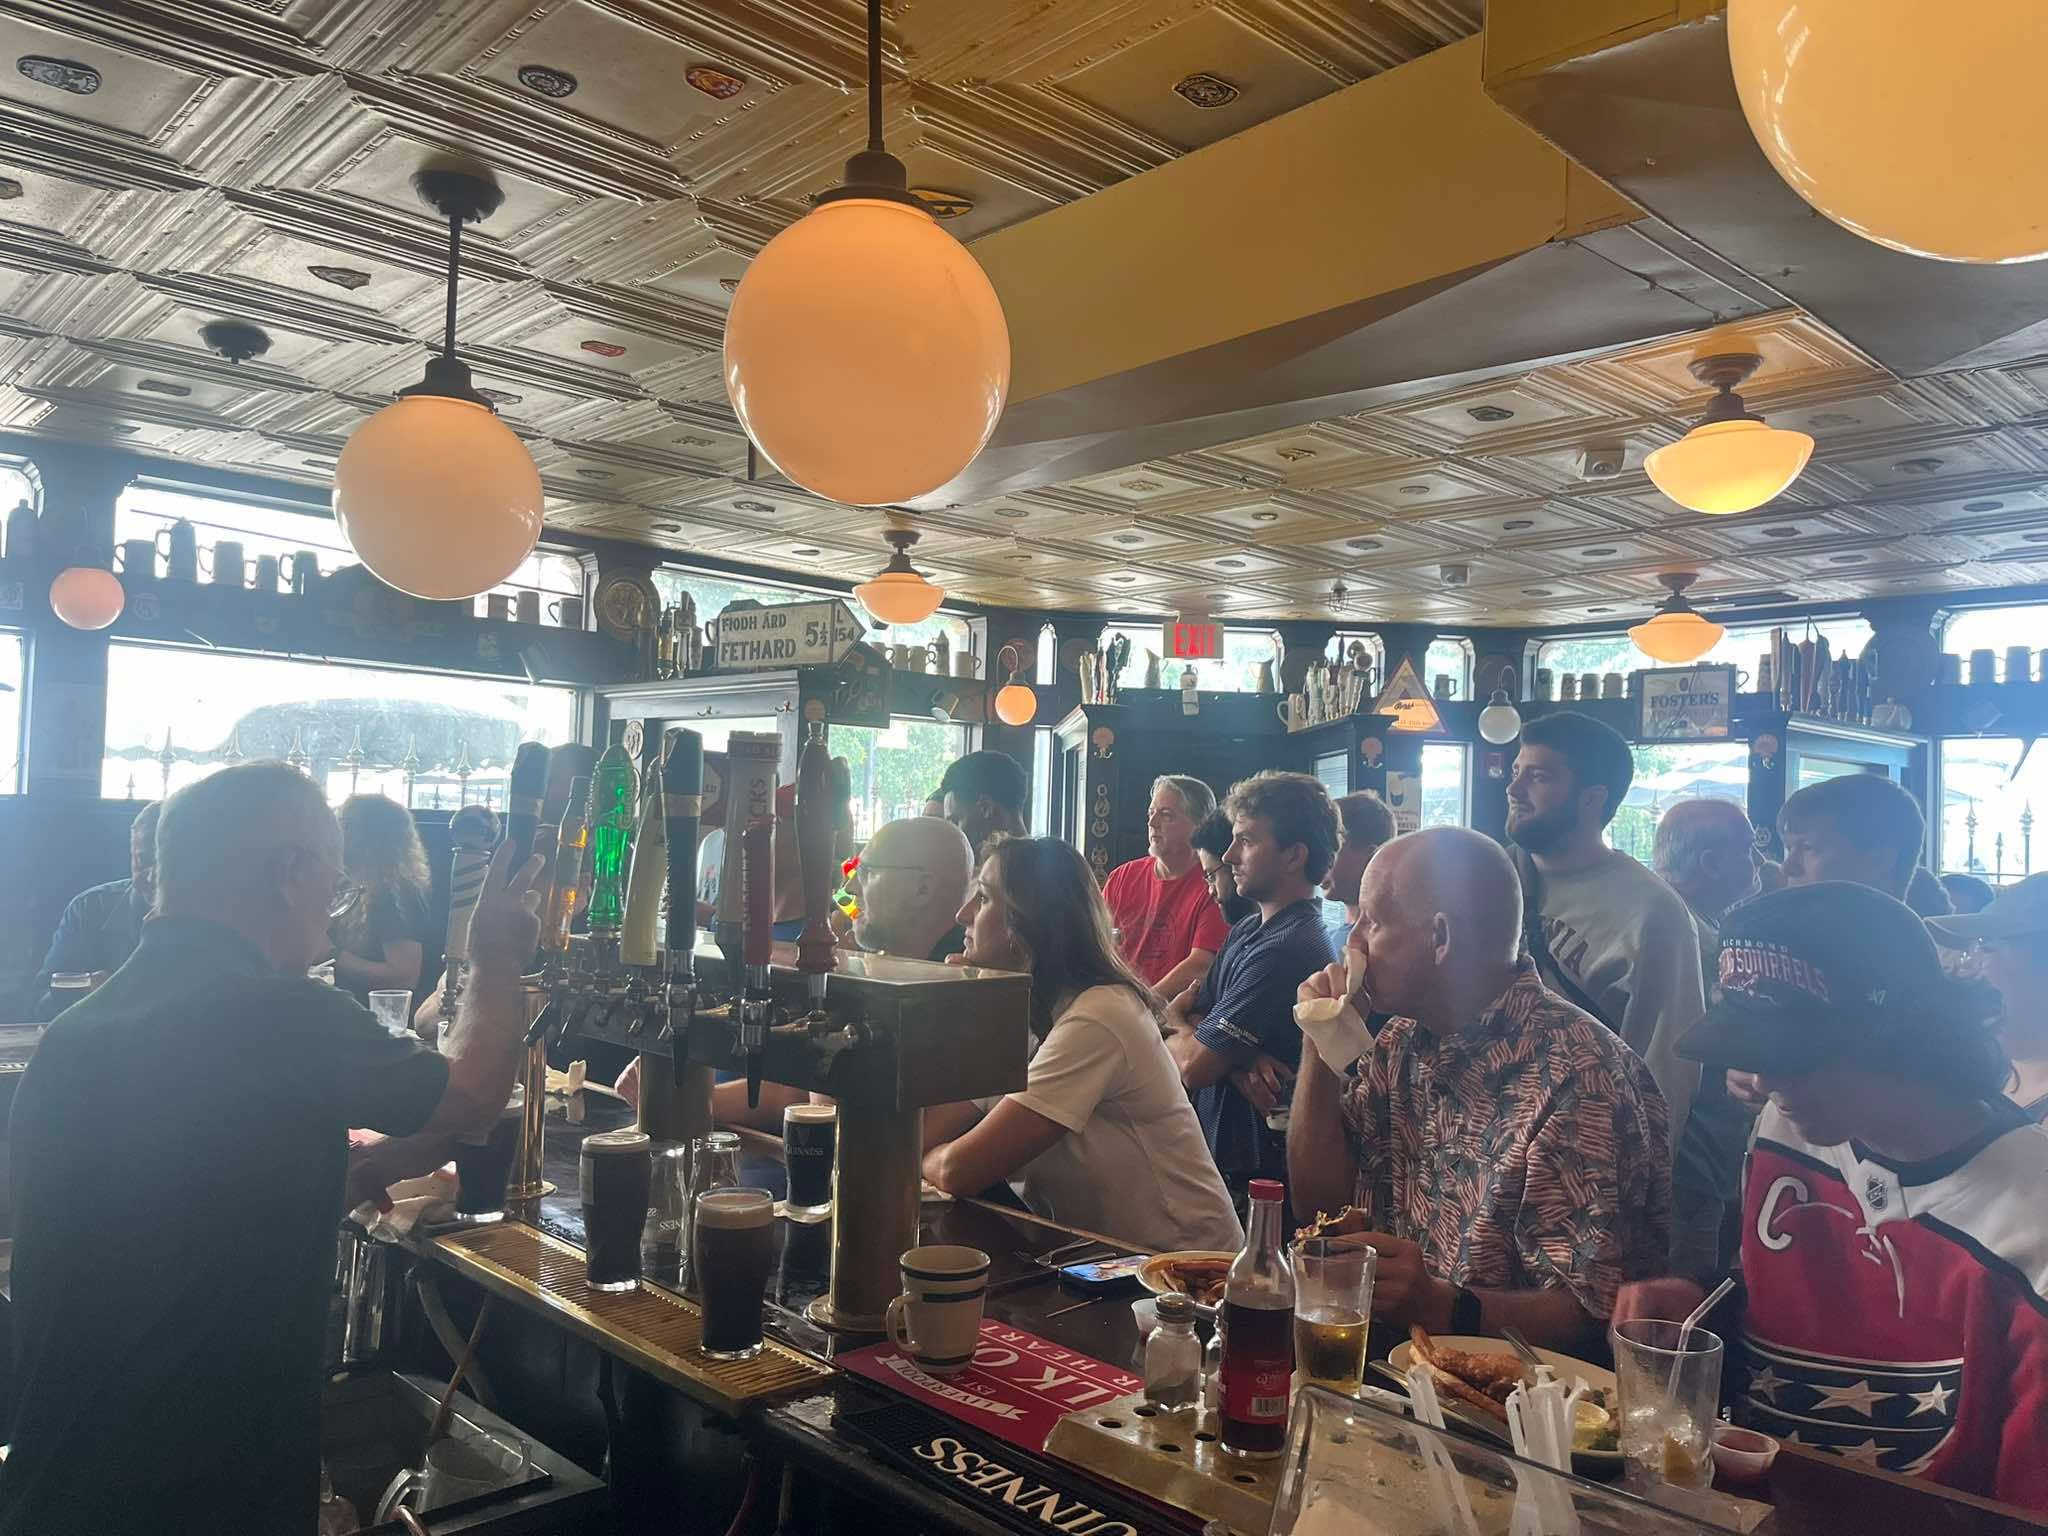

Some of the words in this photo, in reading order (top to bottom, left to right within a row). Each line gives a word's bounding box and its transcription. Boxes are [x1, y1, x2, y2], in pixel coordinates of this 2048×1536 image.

[721, 616, 758, 632] FIODH
[762, 611, 787, 630] ÁRD
[720, 638, 797, 662] FETHARD
[1173, 623, 1216, 657] EXIT
[1649, 690, 1720, 709] FOSTER'S
[895, 1358, 995, 1410] LIVERPOOL
[1011, 1364, 1124, 1405] LK
